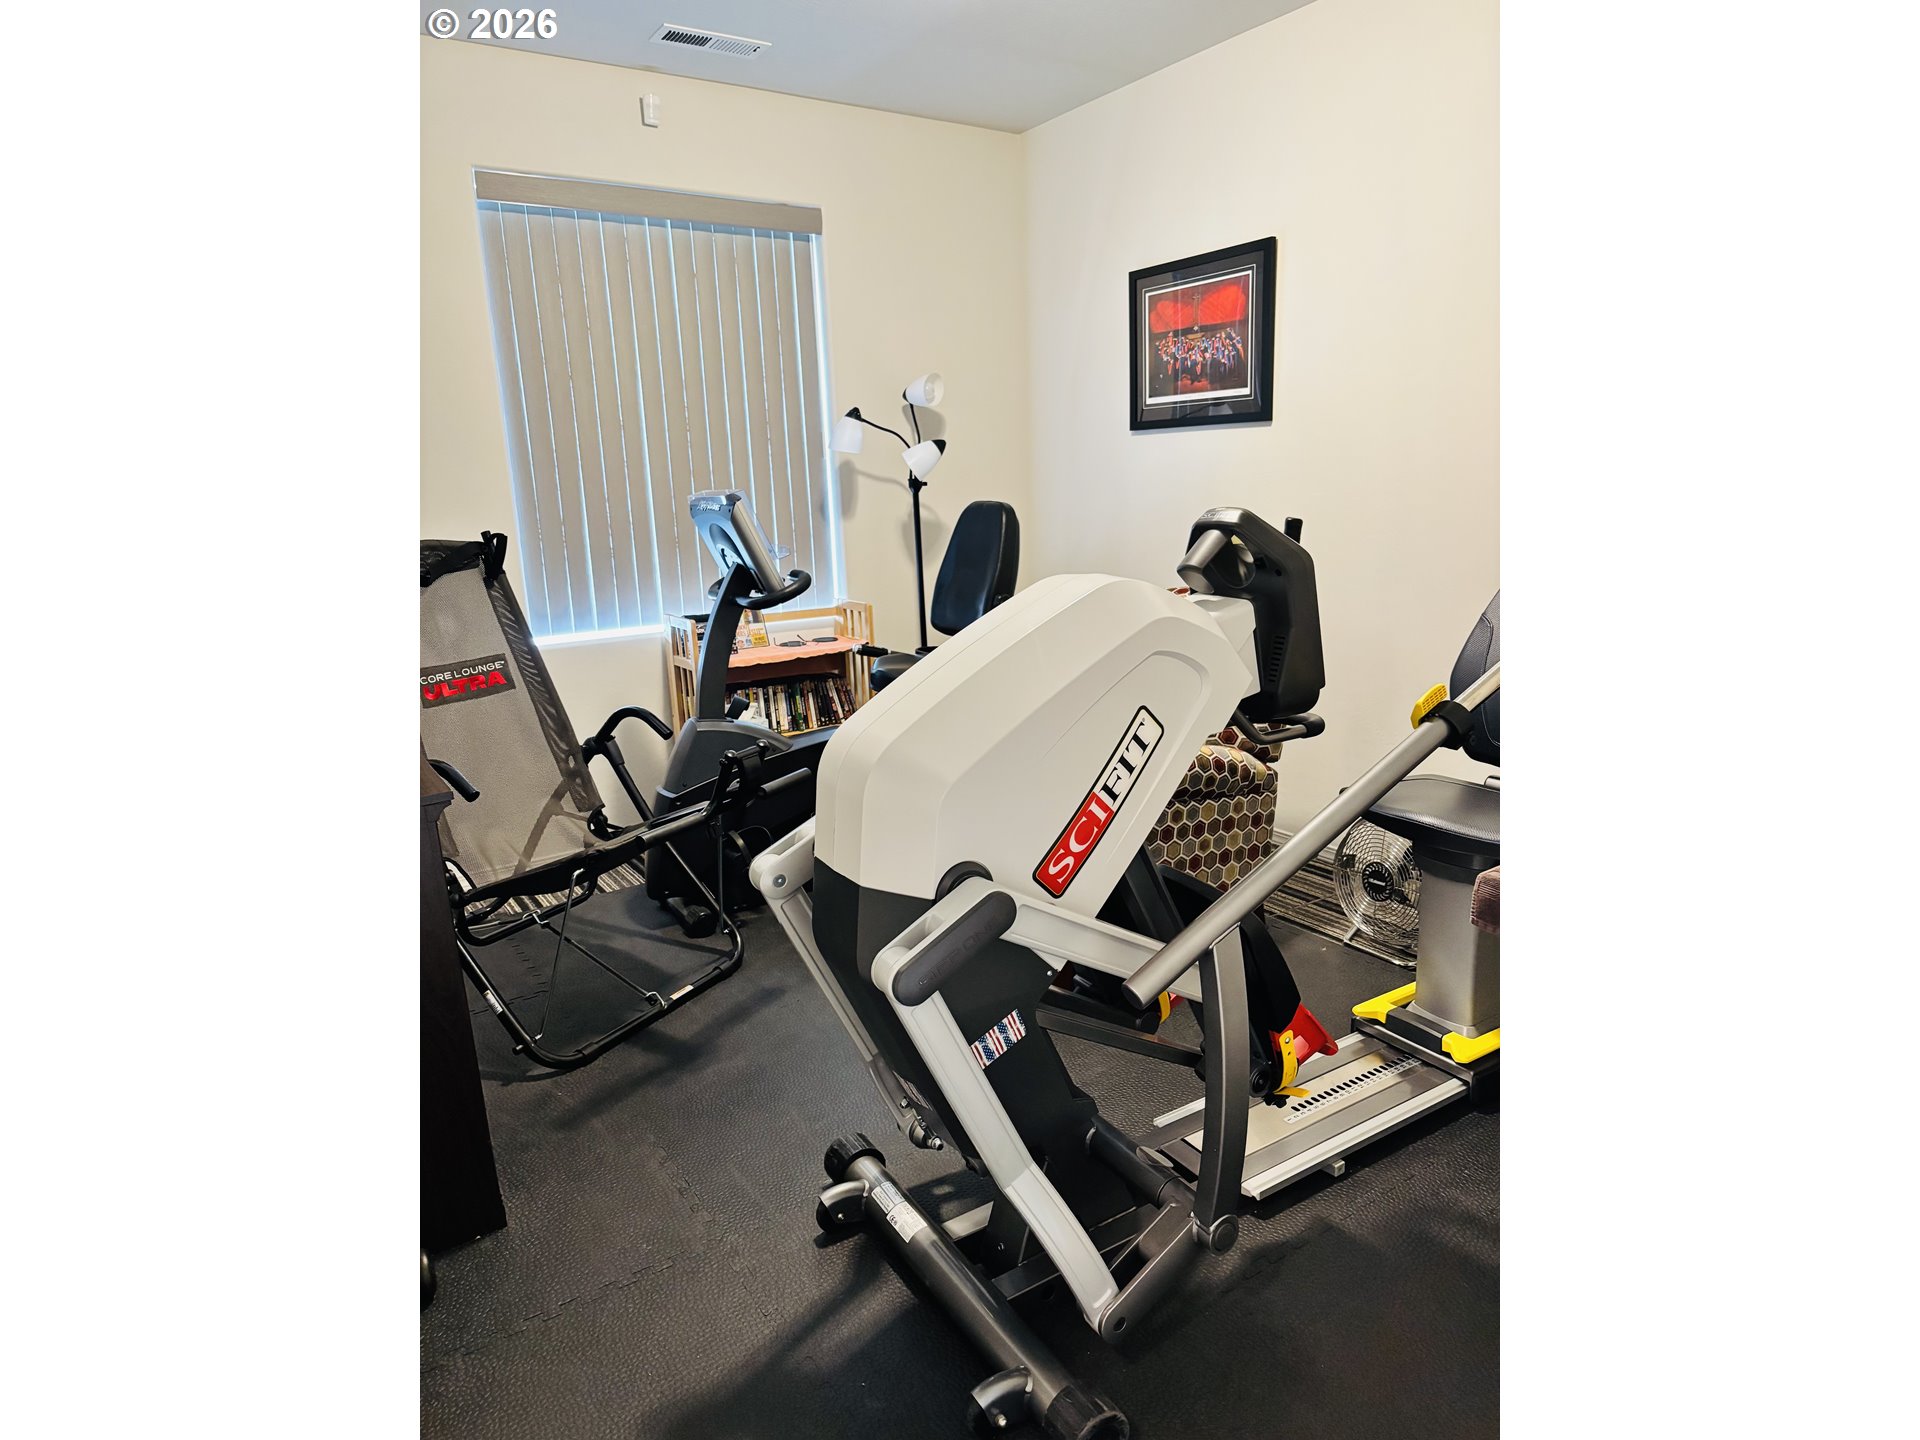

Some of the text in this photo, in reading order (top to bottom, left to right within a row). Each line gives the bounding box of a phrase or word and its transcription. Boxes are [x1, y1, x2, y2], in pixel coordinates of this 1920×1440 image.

[420, 671, 453, 685] CORE
[422, 671, 507, 700] ULTRA
[1048, 720, 1150, 884] SCIFIT
